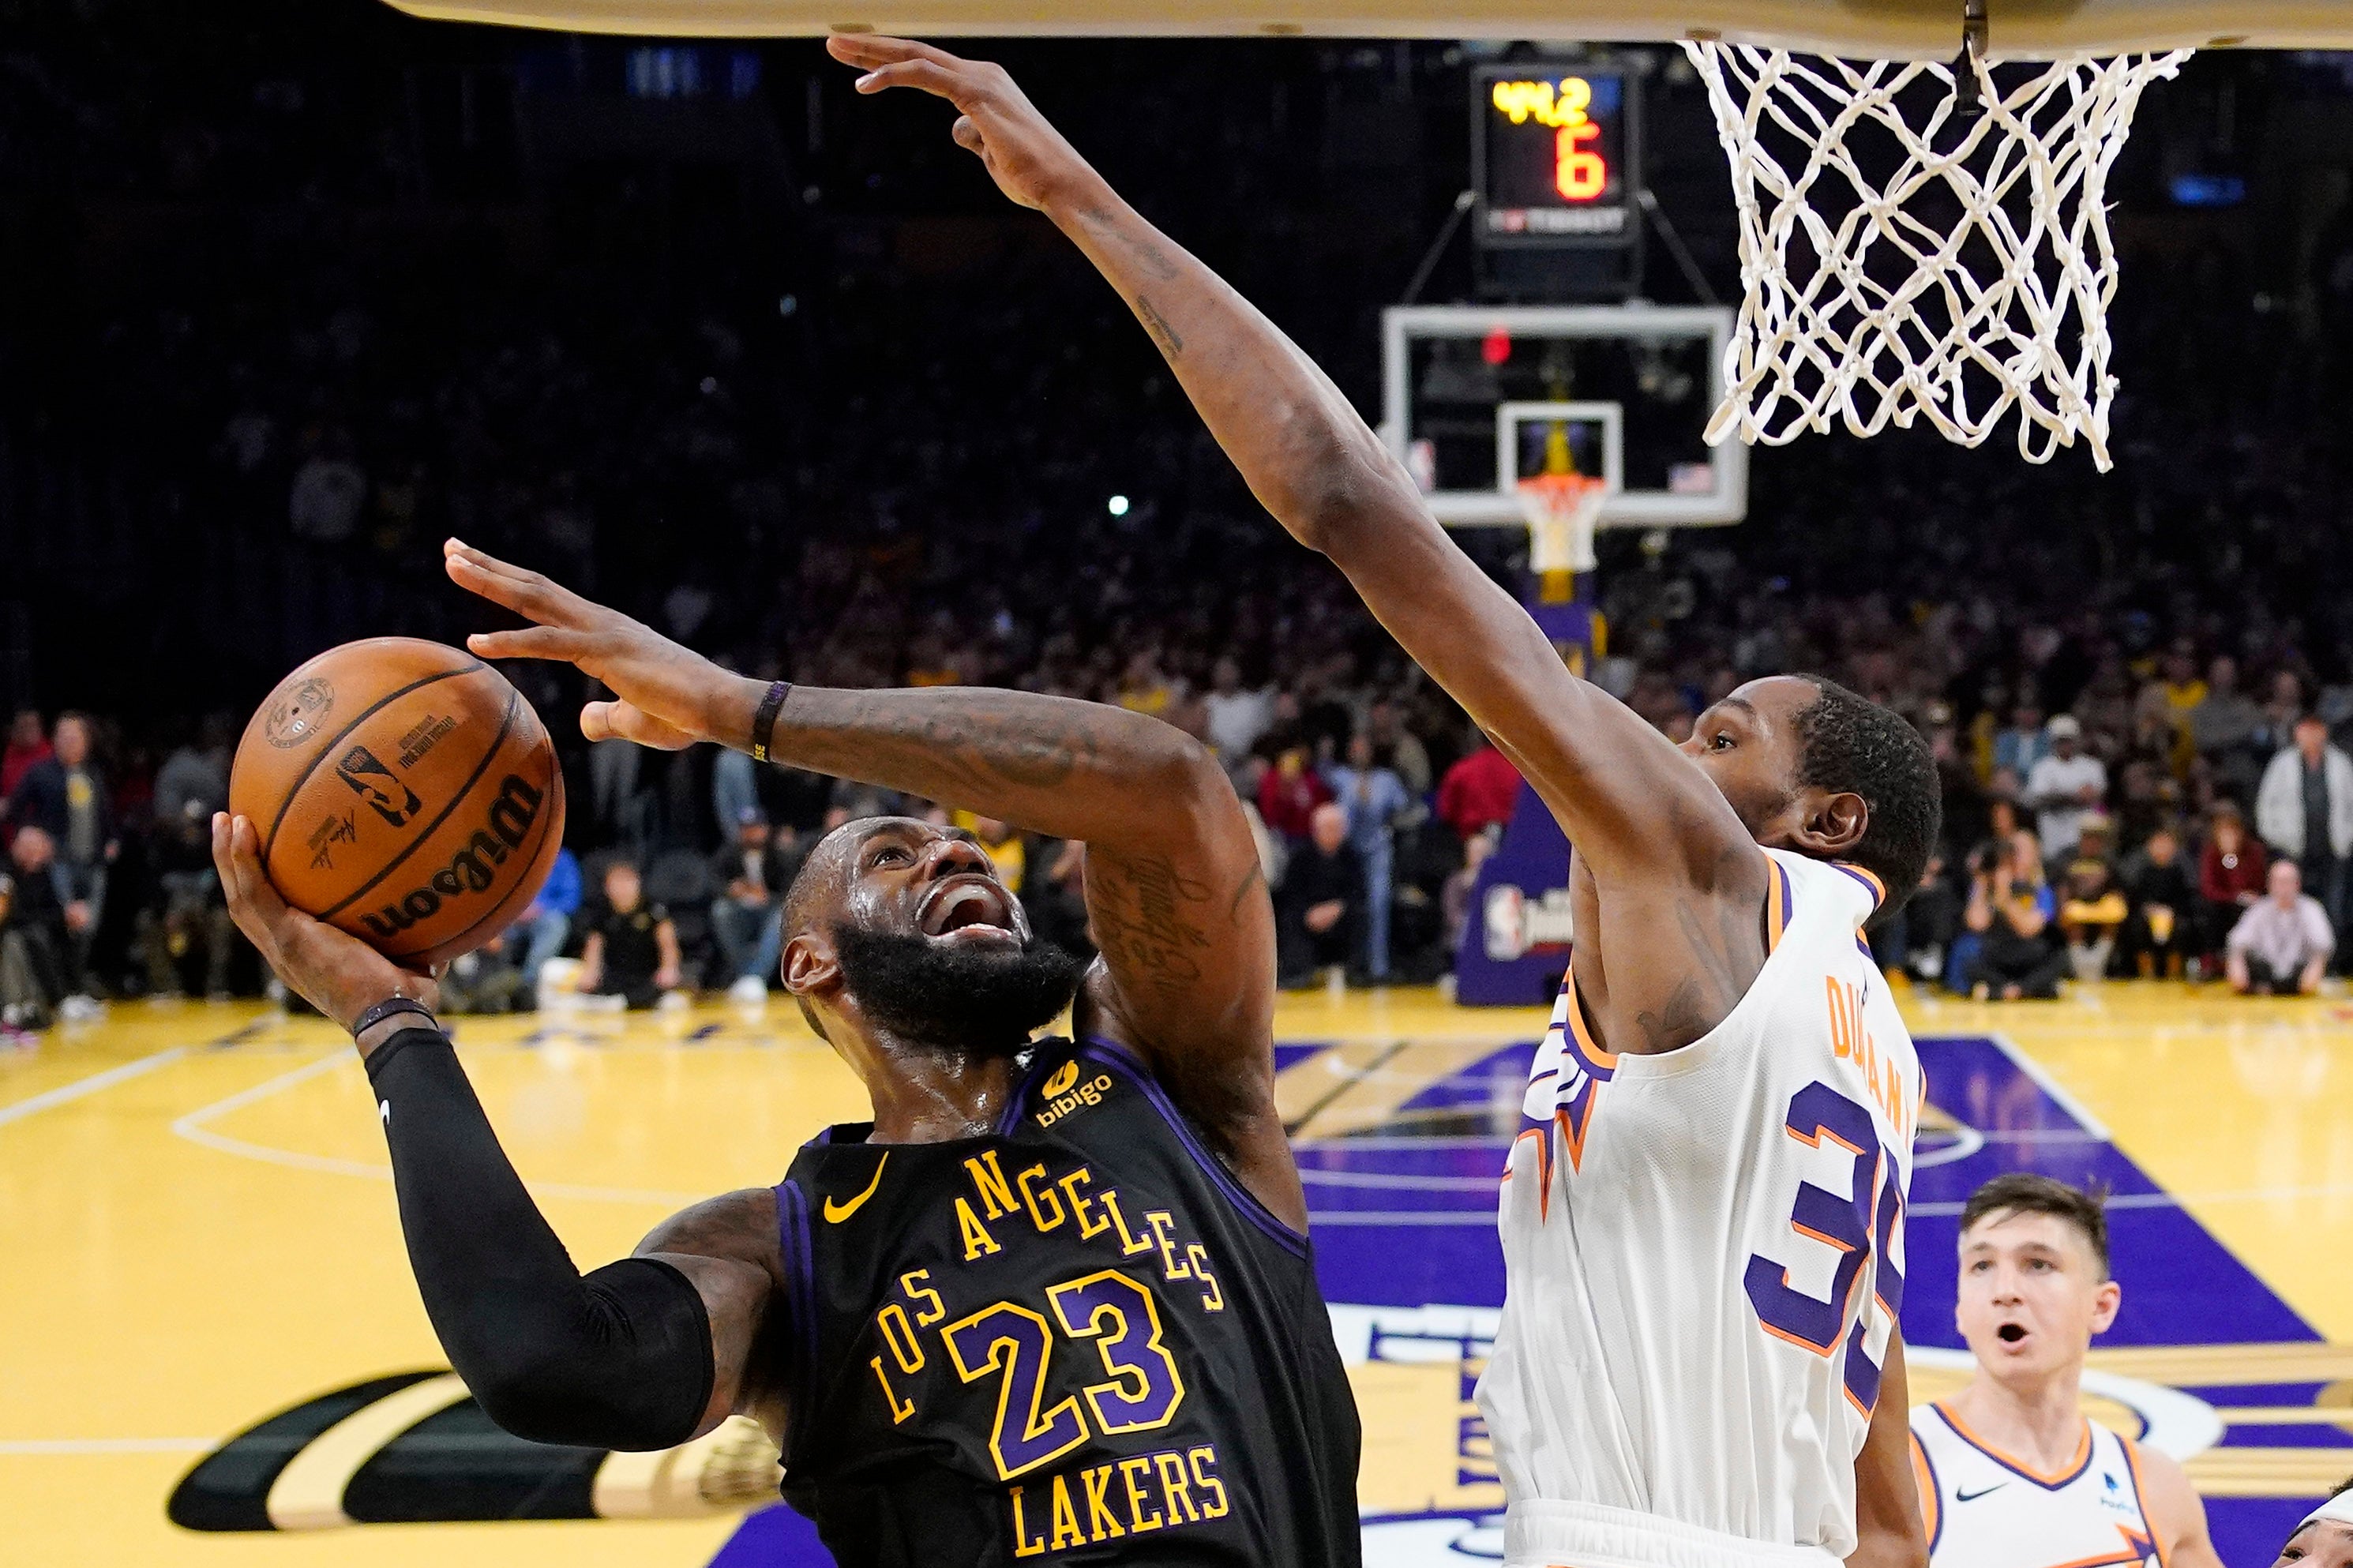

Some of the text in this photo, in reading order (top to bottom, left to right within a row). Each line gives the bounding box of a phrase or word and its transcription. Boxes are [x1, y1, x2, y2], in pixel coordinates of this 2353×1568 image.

[1555, 121, 1606, 201] 6
[358, 774, 545, 937] Wilson
[1034, 1071, 1113, 1128] bibigo
[1826, 974, 1911, 1154] DUAN
[869, 1148, 1226, 1426] LOS ANGELES
[940, 1268, 1186, 1483] 23
[1008, 1443, 1231, 1559] LAKERS
